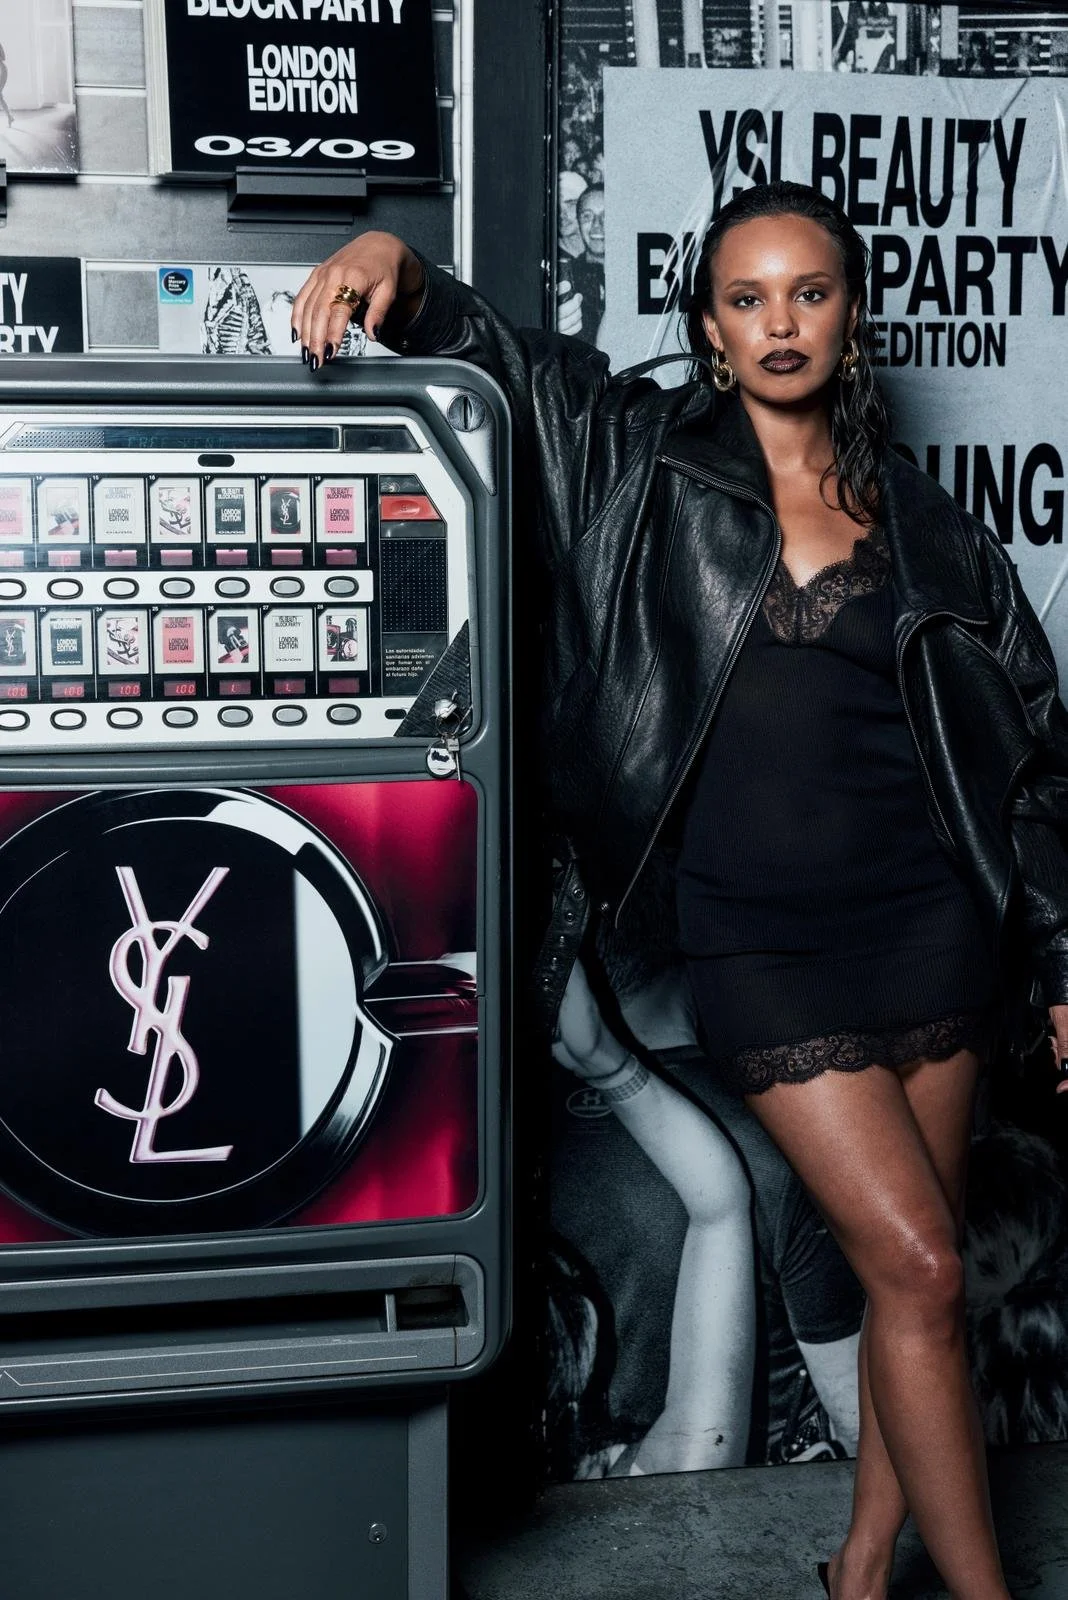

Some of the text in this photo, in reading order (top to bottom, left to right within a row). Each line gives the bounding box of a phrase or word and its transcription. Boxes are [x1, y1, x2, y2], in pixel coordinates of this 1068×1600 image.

[246, 44, 356, 80] LONDON
[249, 79, 359, 114] EDITION
[194, 135, 416, 160] 03/09
[812, 112, 1027, 228] BEAUTY
[870, 235, 1068, 316] PARTY
[866, 321, 1007, 368] EDITION
